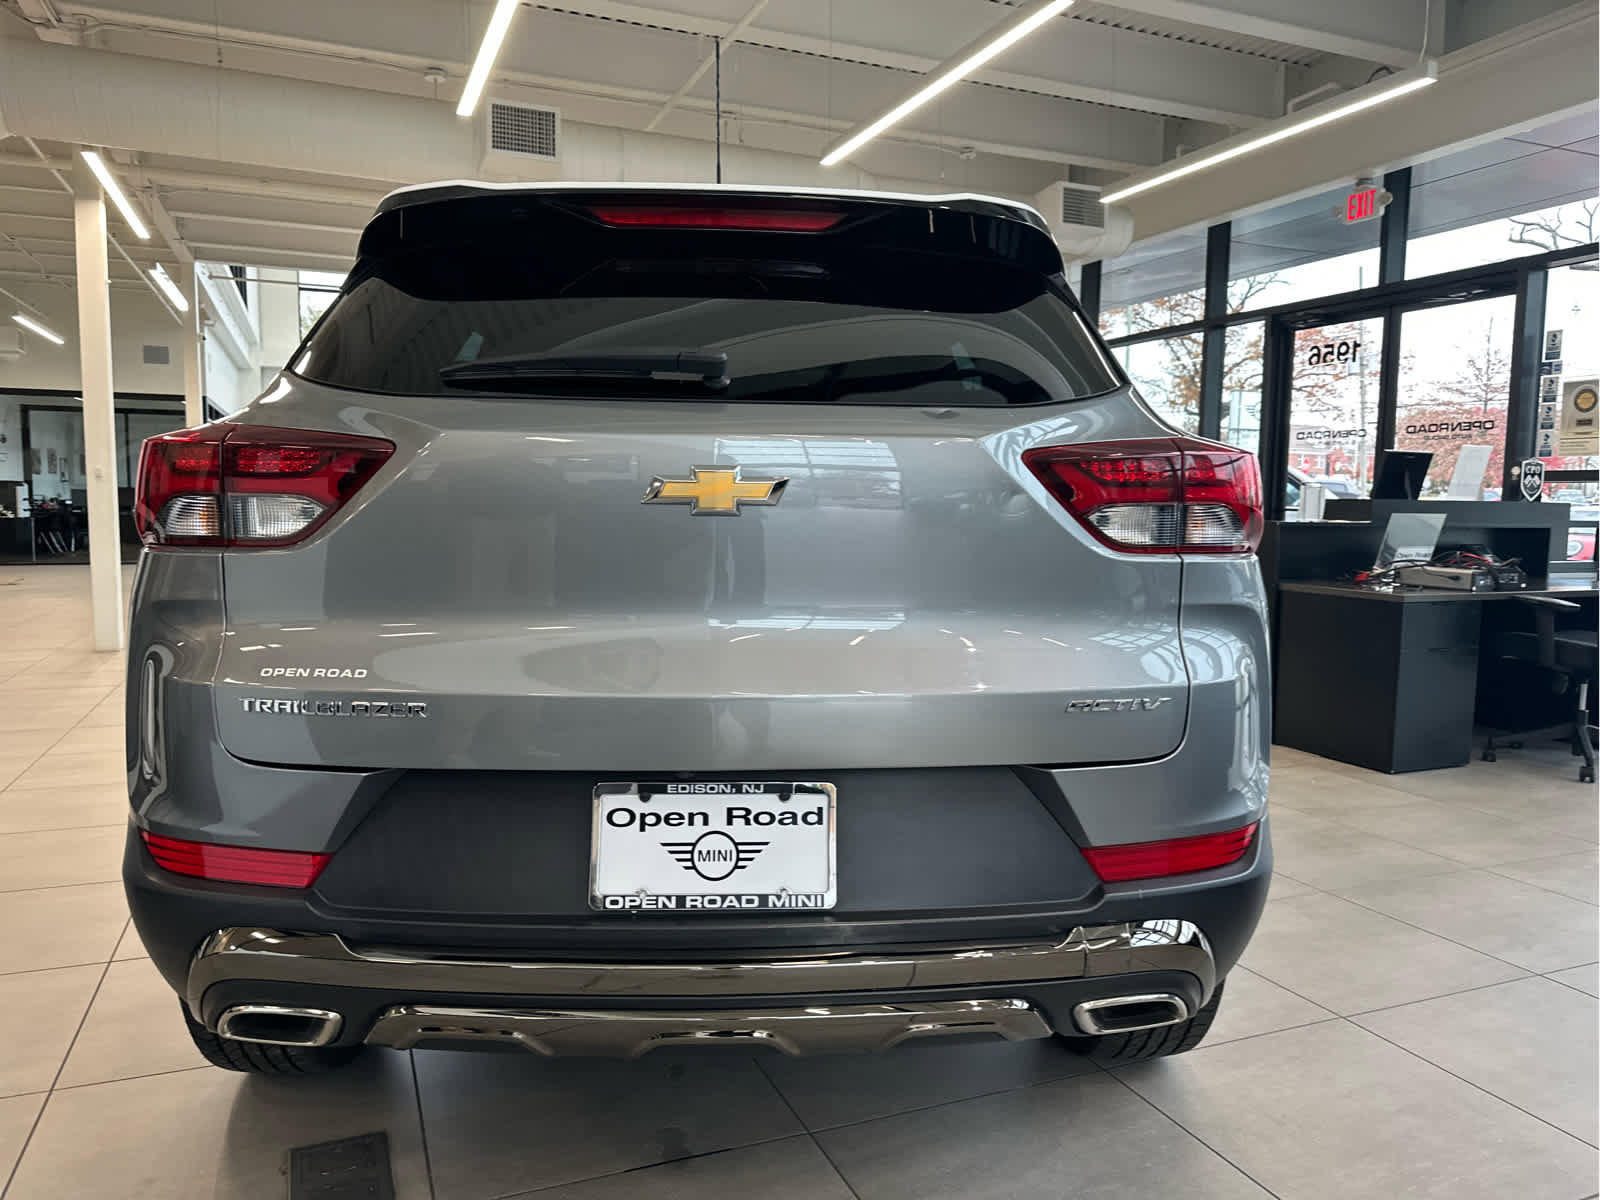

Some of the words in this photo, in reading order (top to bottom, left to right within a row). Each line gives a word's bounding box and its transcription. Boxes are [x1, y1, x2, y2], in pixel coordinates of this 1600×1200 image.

[1347, 189, 1376, 221] EXIT
[260, 667, 310, 678] OPEN
[313, 668, 368, 679] ROAD
[240, 697, 428, 719] TRAILBLAZER
[1065, 697, 1172, 712] ACTIV
[667, 784, 736, 794] EDISON,
[742, 784, 764, 794] NJ
[606, 807, 710, 833] Open
[726, 806, 824, 826] Road
[697, 849, 734, 862] MINI
[604, 895, 677, 910] OPEN
[685, 895, 760, 909] ROAD
[768, 893, 824, 908] MINI
